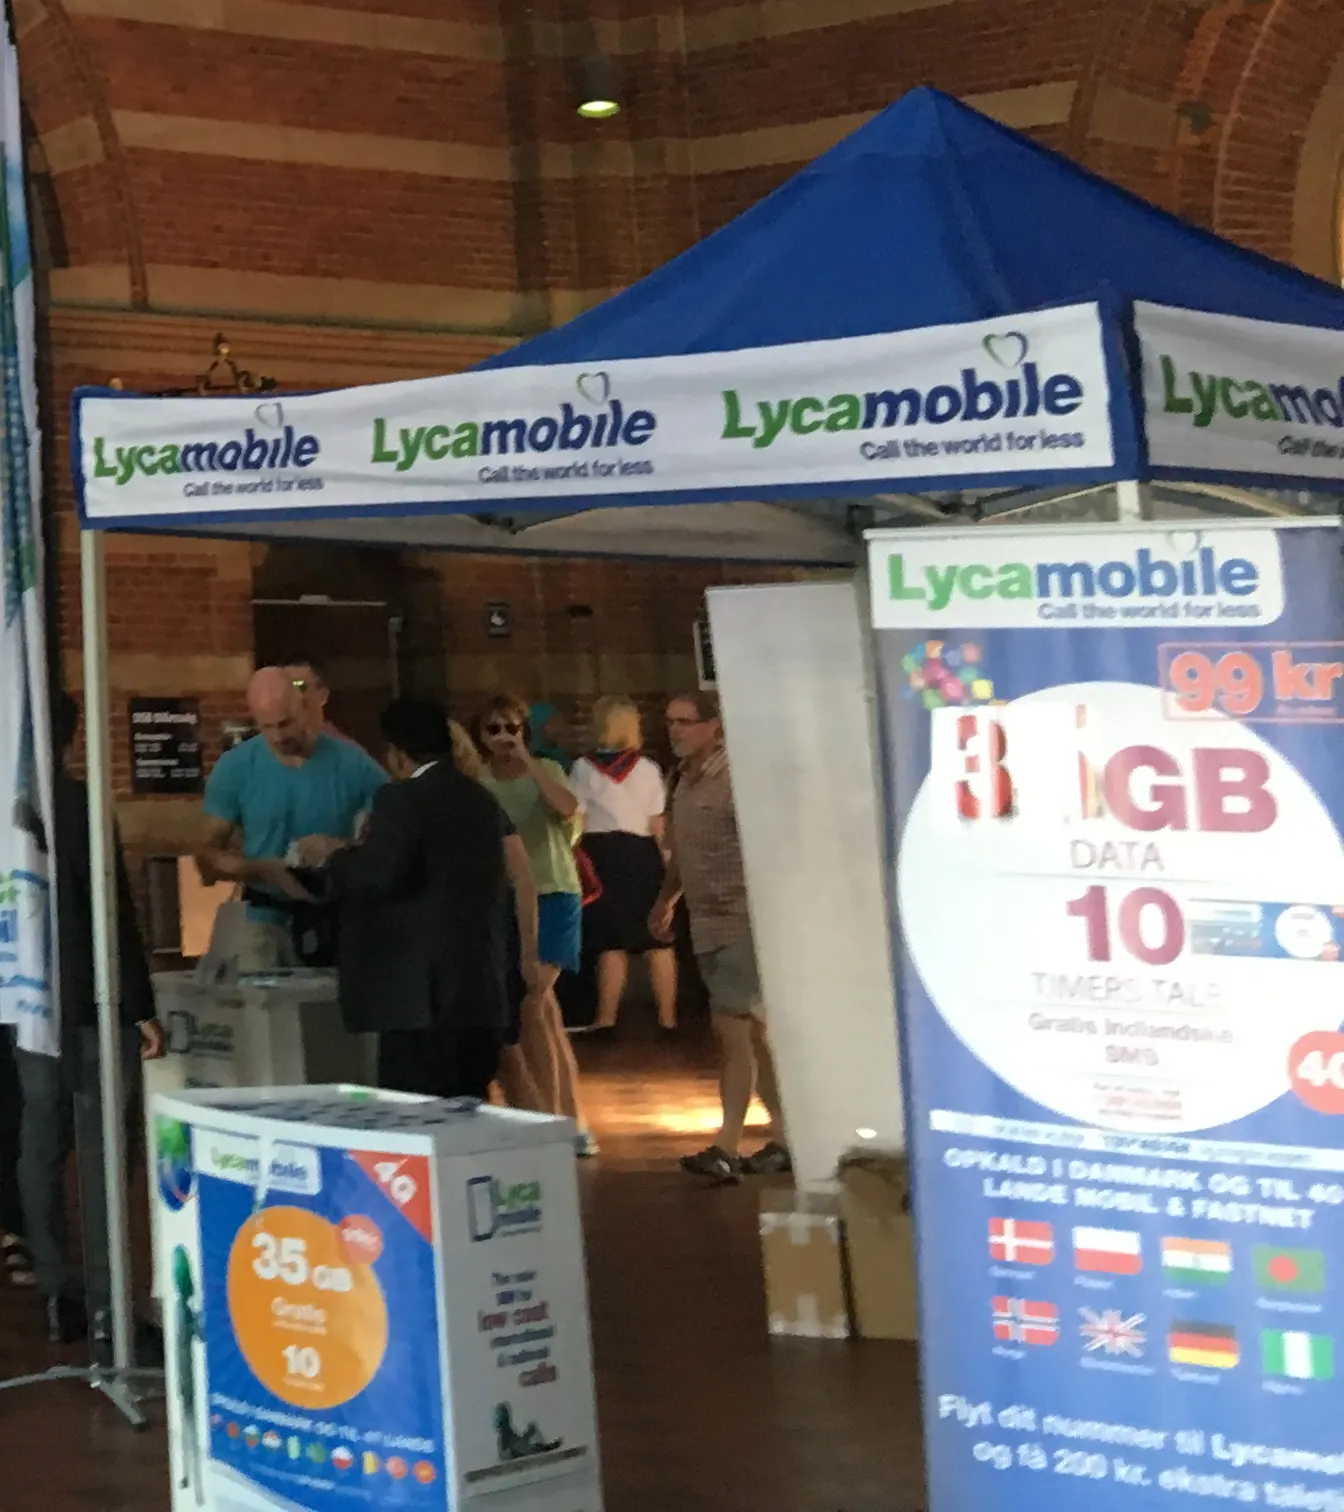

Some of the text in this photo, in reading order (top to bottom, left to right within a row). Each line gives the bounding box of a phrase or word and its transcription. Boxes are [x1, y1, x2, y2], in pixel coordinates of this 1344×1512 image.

[370, 399, 657, 471] Lycamobile
[721, 362, 1084, 449] Lycamobile
[94, 425, 321, 486] Lycamobile
[543, 462, 589, 481] world
[904, 437, 938, 458] the
[942, 433, 1002, 455] world
[887, 547, 1259, 610] Lycamobile
[1169, 649, 1342, 714] 99 kr
[1070, 839, 1165, 872] DATA
[1066, 885, 1186, 966] 10
[252, 1231, 309, 1285] 35
[282, 1344, 321, 1378] 10
